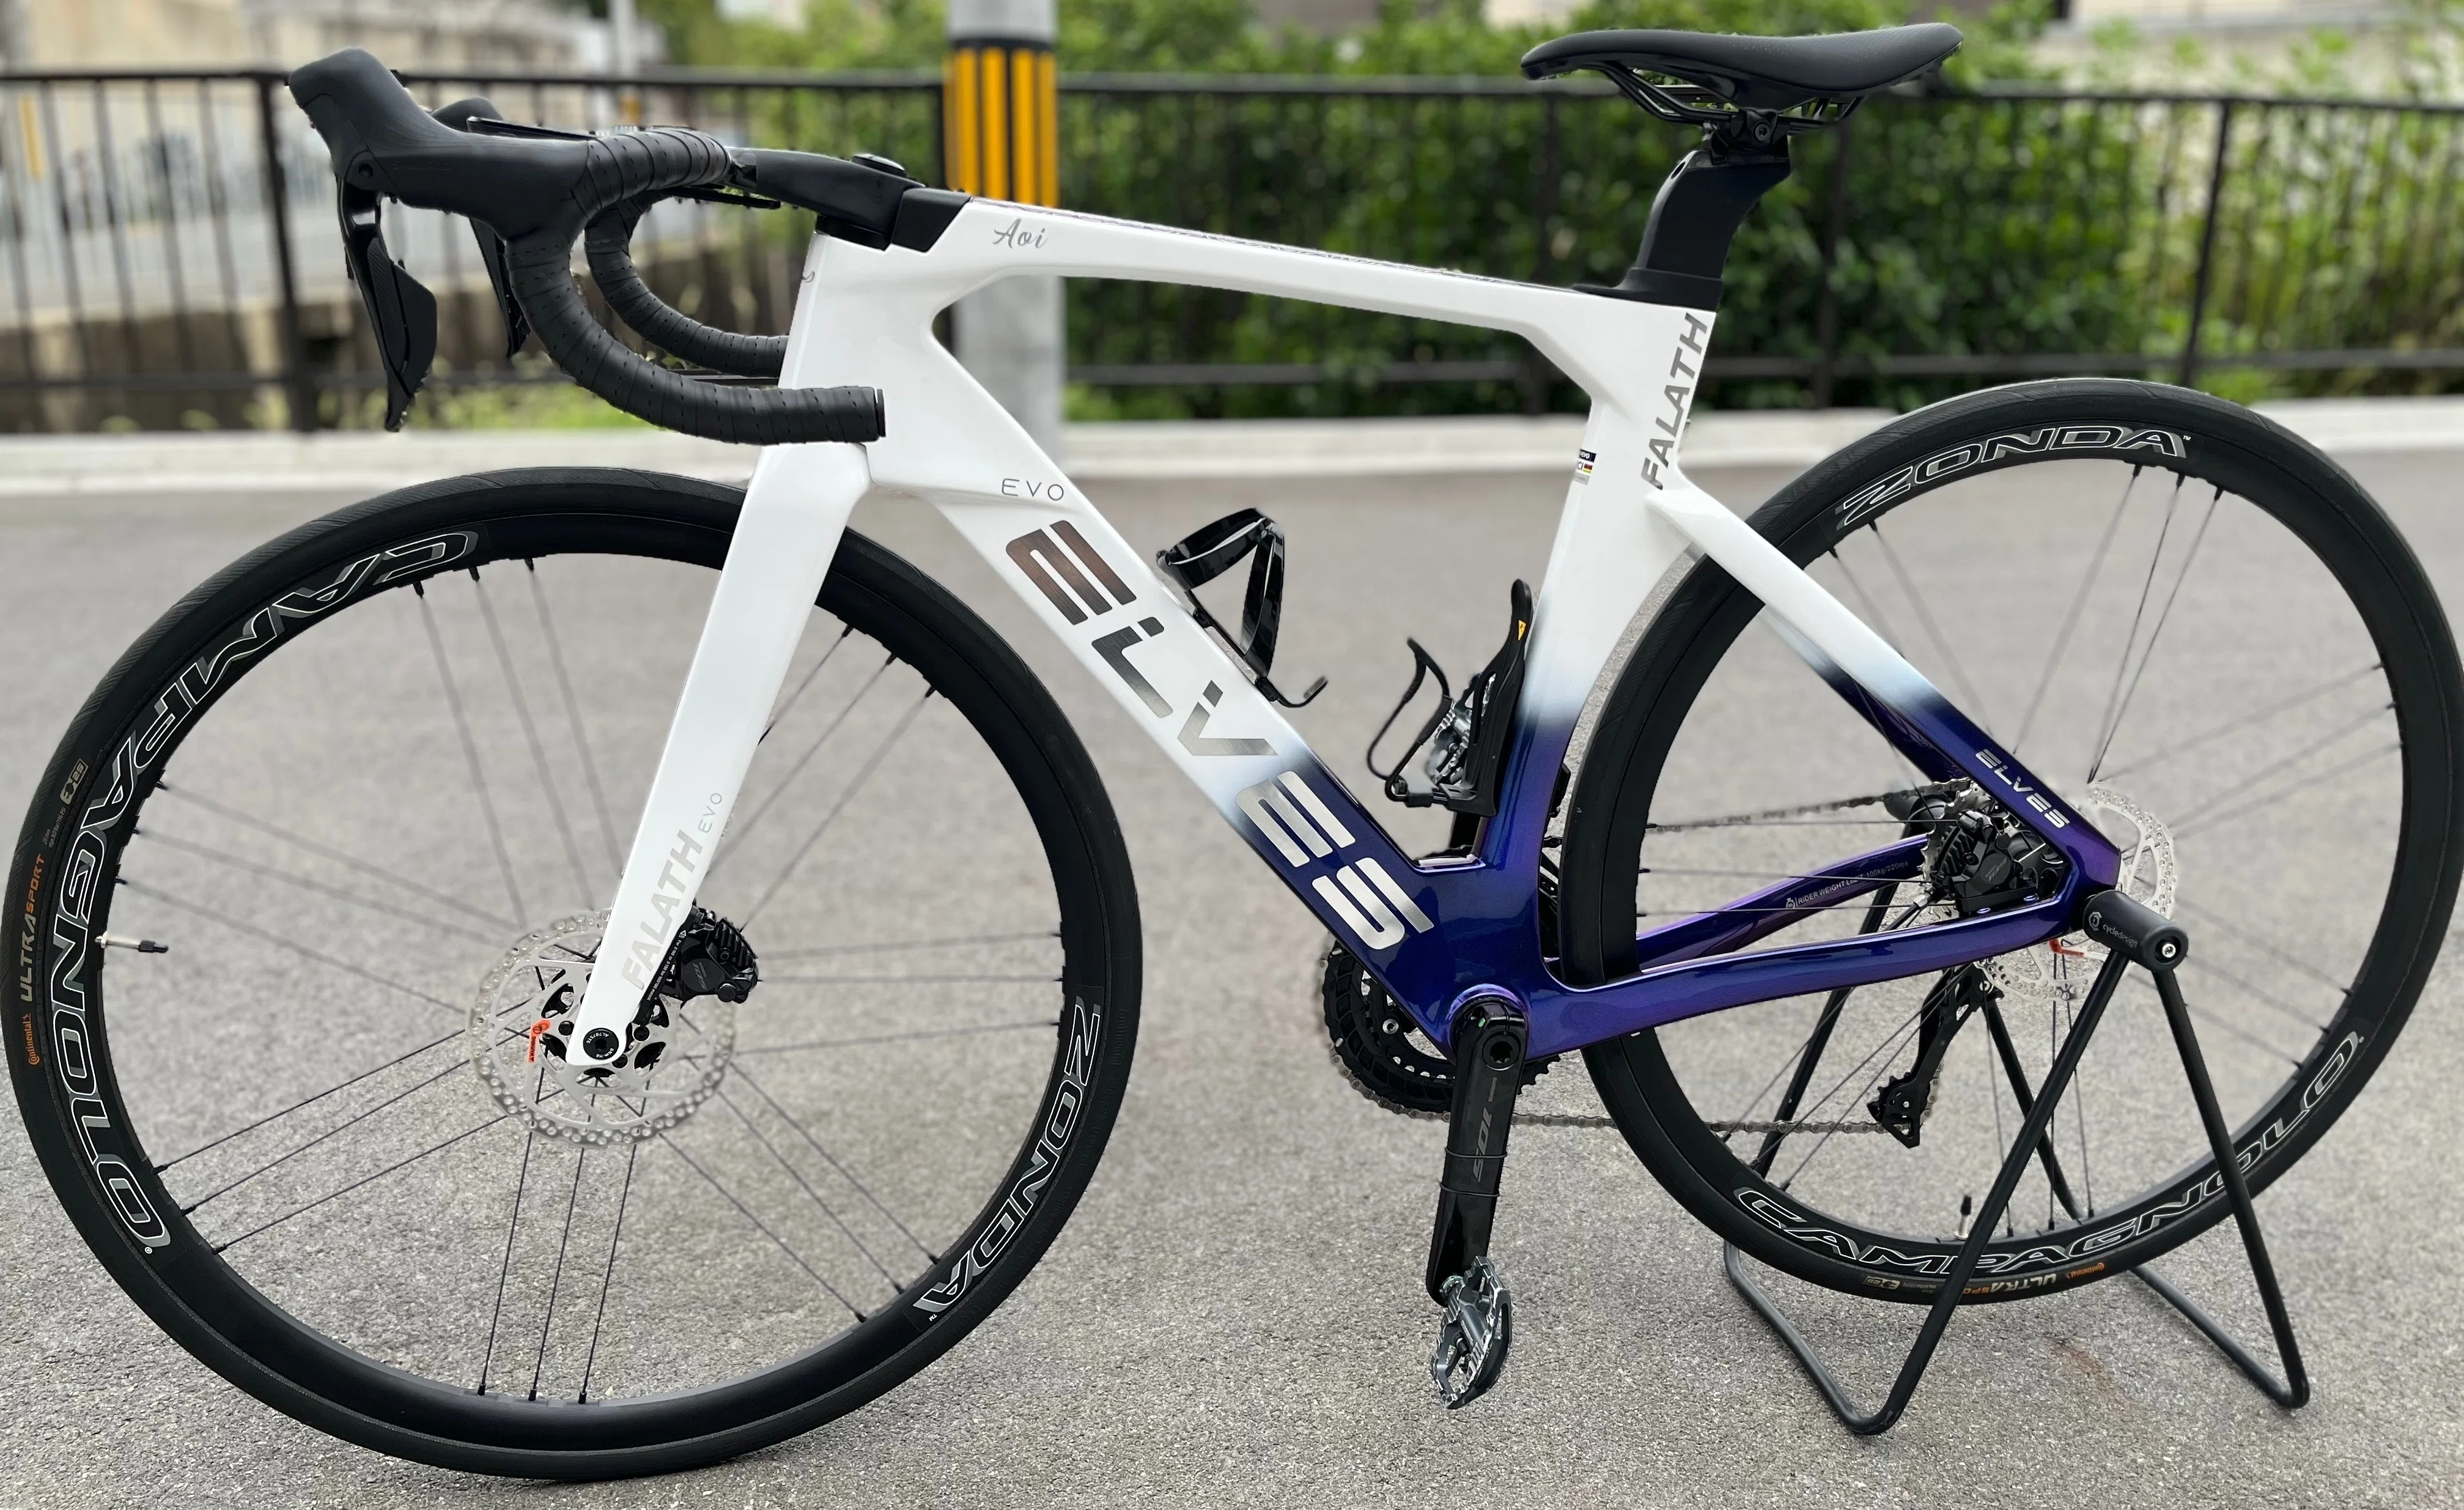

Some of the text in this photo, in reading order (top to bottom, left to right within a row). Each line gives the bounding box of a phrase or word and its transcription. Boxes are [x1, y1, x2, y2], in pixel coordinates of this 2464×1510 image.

[992, 218, 1048, 249] Aoi
[1640, 312, 1708, 490] FALATH
[1001, 478, 1065, 501] EVO
[1835, 424, 2187, 531] ZONDA
[1006, 519, 1435, 950] ELVES
[1975, 749, 2070, 828] ELVES
[51, 531, 479, 1248] CAMPAGNOLO
[621, 793, 723, 991] FALATH EVO
[1798, 891, 1819, 905] RIDER
[1818, 881, 1846, 897] WEIGHT
[2103, 924, 2138, 948] cycledesign
[23, 1020, 41, 1066] Continental
[913, 996, 1101, 1312] ZONDA
[1473, 1107, 1492, 1183] 105
[2070, 1262, 2105, 1279] Continental
